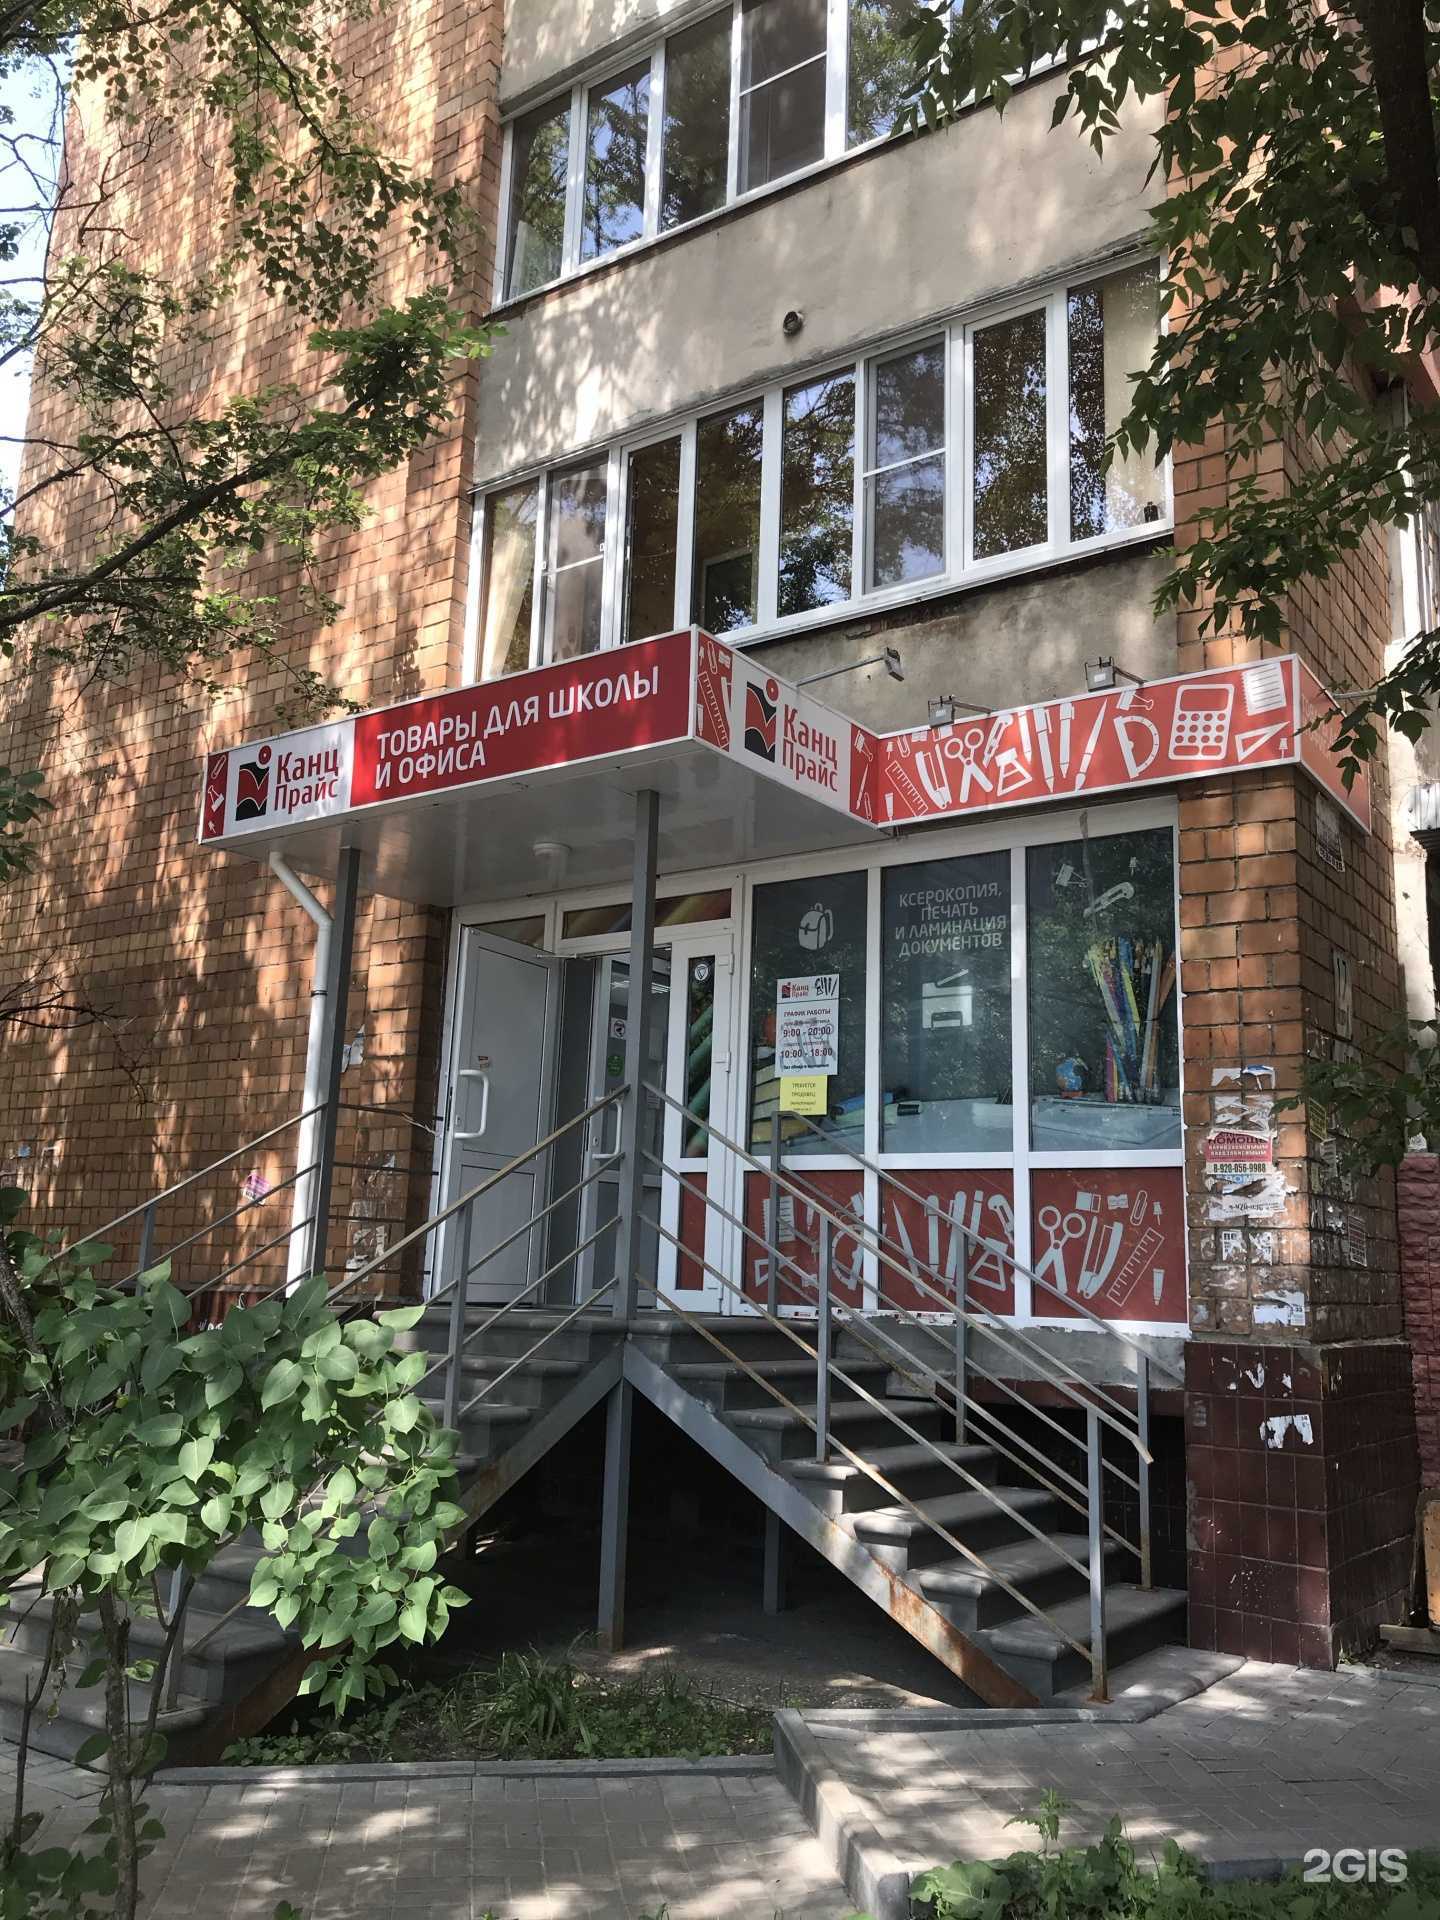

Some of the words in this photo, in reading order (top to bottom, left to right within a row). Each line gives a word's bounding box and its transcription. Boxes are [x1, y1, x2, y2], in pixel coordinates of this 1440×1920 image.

[377, 711, 477, 759] ТОВАРЫ
[484, 695, 539, 739] ДЛЯ
[549, 666, 659, 719] ШКОЛЫ
[783, 703, 838, 770] Канц
[277, 749, 339, 784] Канц
[375, 762, 391, 790] И
[399, 740, 486, 784] ОФИСА
[782, 738, 838, 792] Прайс
[274, 776, 339, 814] Прайс
[899, 882, 1002, 907] КСЕРОКОПИЯ,
[921, 902, 979, 920] ПЕЧАТЬ
[895, 926, 905, 939] И
[909, 915, 1007, 939] ЛАМИНАЦИЯ
[898, 932, 1002, 958] ДОКУМЕНТОВ
[806, 1008, 831, 1016] РАБОТЫ
[783, 1028, 800, 1037] 9:00
[808, 1026, 831, 1036] 20:00
